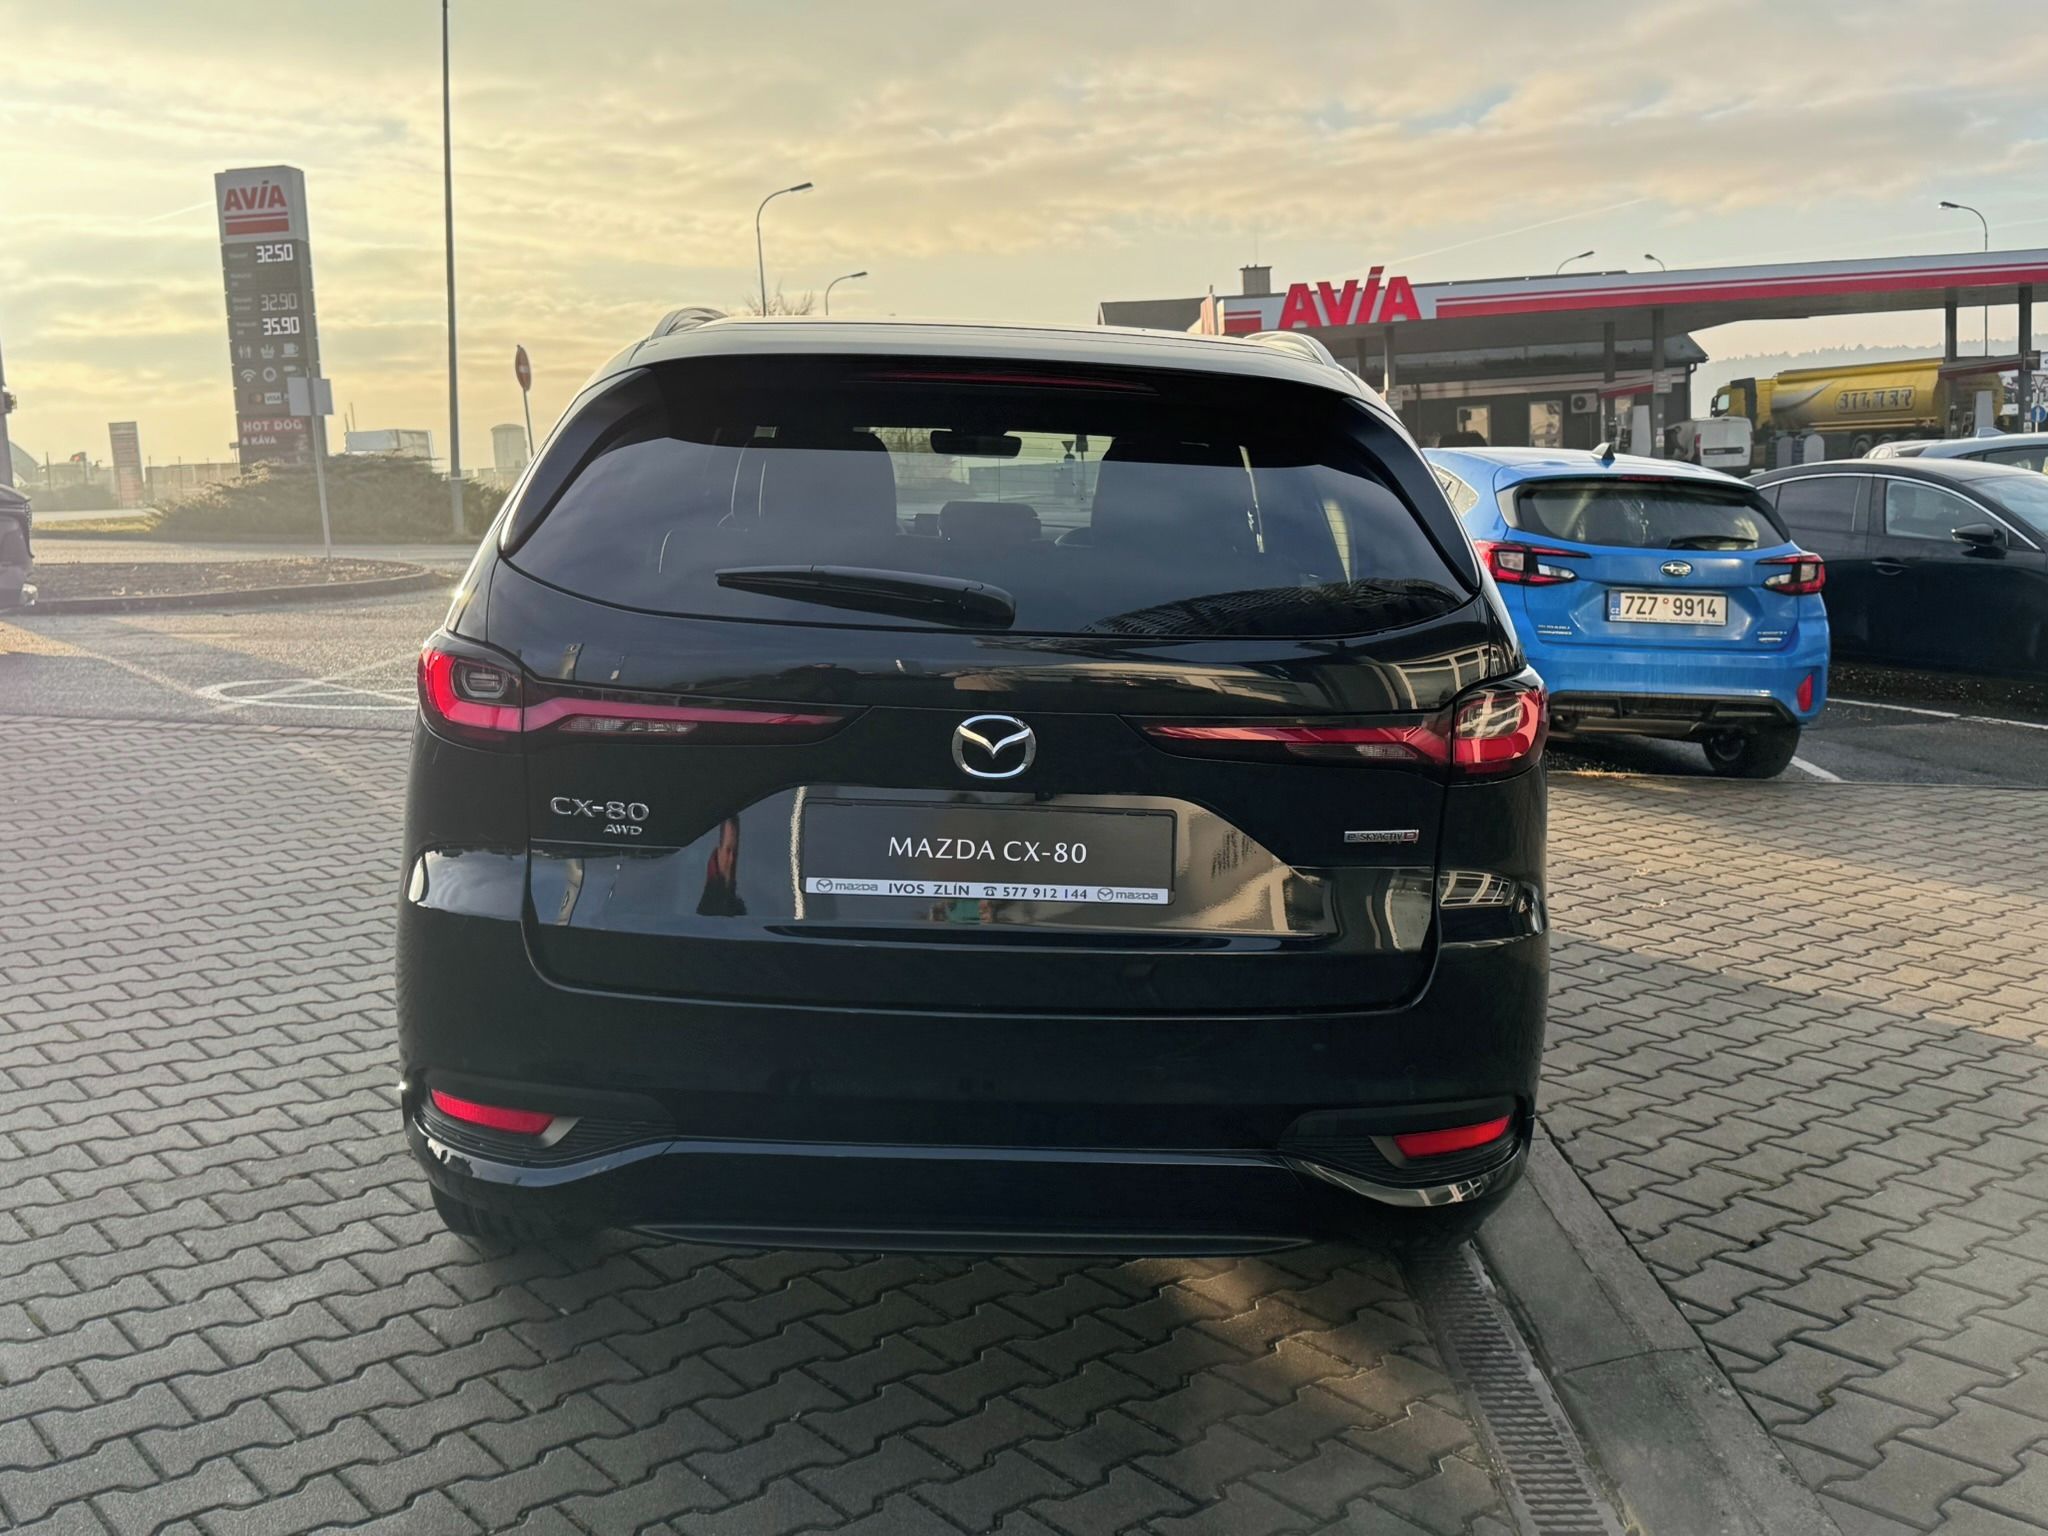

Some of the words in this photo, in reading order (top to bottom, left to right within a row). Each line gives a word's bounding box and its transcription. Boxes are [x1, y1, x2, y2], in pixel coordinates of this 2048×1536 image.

[255, 243, 294, 263] 32.50
[262, 316, 301, 336] 35.90
[242, 420, 270, 433] HOT
[273, 419, 303, 432] DOG
[1624, 595, 1659, 615] 7Z7
[1672, 597, 1717, 618] 9914
[550, 796, 650, 822] CX-80
[603, 824, 643, 836] AWD
[887, 836, 996, 861] MAZDA
[1003, 841, 1088, 864] CX-80
[835, 881, 879, 892] mazda
[888, 882, 925, 895] IVOS
[933, 882, 970, 896] ZLÍN
[1003, 886, 1028, 898] 577
[1033, 887, 1058, 899] 912
[1063, 888, 1088, 900] 144
[1115, 890, 1159, 901] mazda
